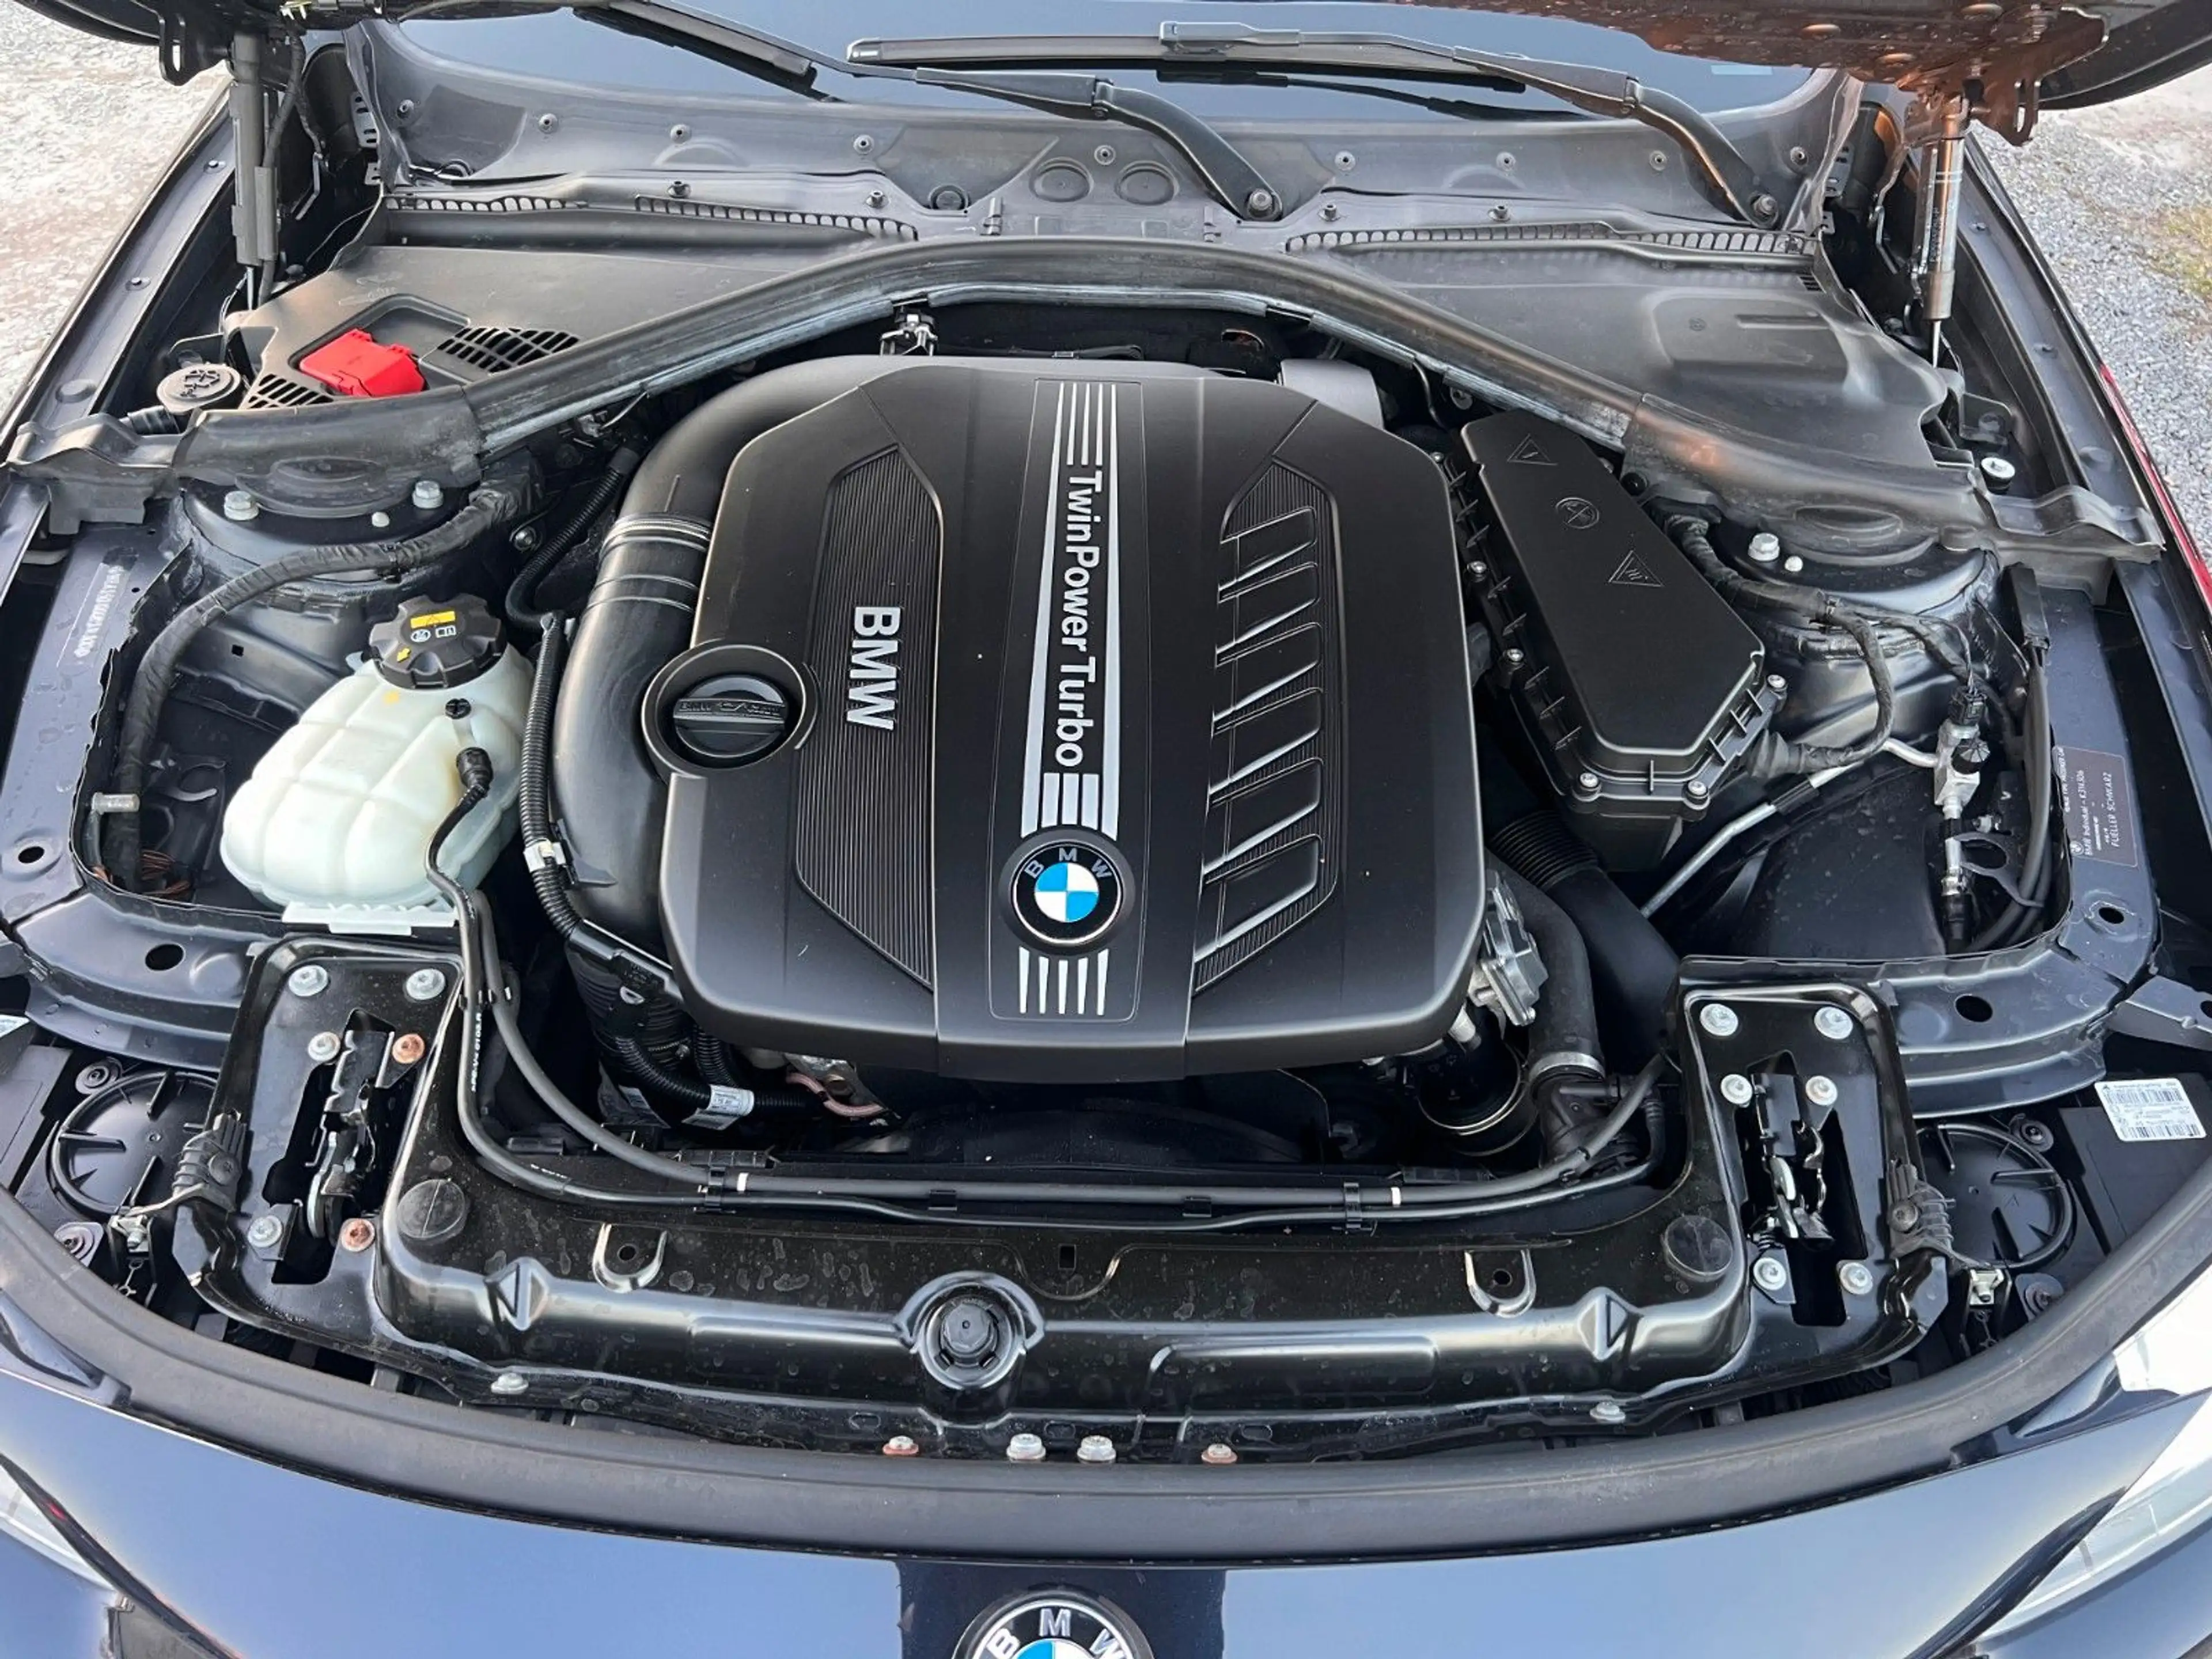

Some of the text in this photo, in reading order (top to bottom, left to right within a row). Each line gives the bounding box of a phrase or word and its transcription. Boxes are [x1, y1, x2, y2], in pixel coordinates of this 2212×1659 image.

[1055, 470, 1103, 767] TwinPower Turbo
[847, 607, 900, 730] BMW
[1024, 847, 1112, 879] BMW
[986, 1608, 1125, 1659] BMW
